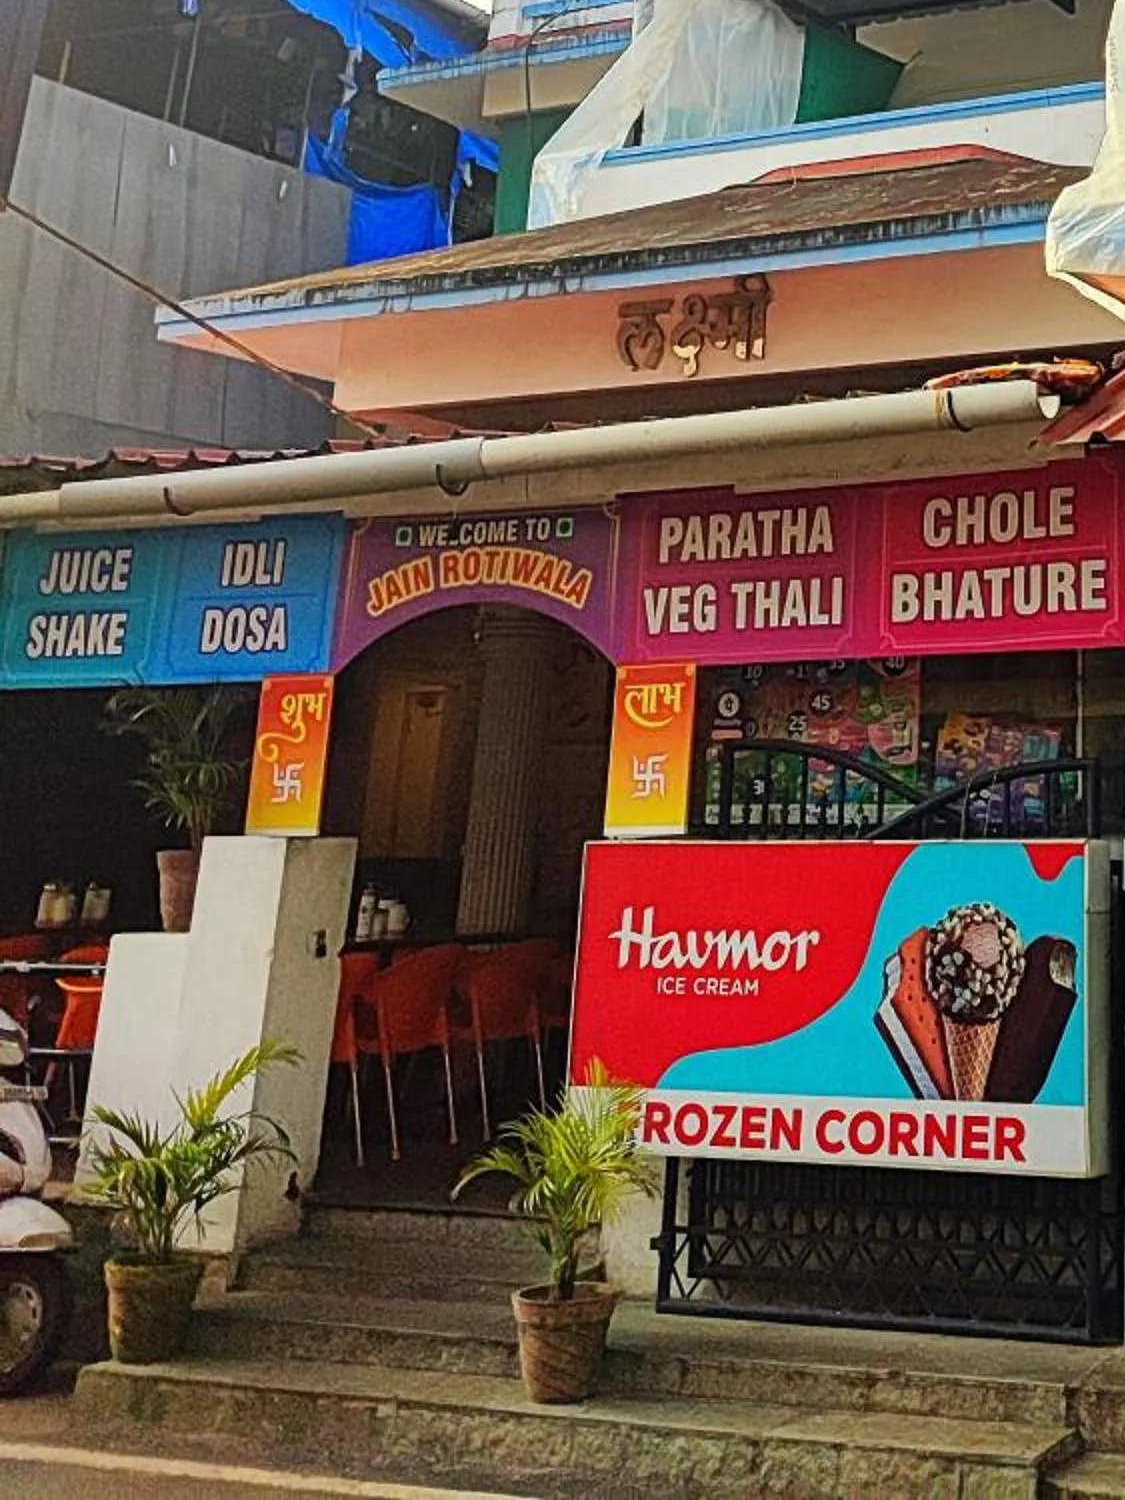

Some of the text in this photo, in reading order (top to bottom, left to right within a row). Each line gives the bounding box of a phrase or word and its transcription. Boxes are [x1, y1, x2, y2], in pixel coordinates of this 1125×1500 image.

[419, 518, 551, 546] WECOME TO
[658, 505, 834, 564] PARATHA
[923, 486, 1076, 548] CHOLE
[39, 548, 134, 595] JUICE
[221, 540, 286, 588] IDLI
[367, 547, 593, 617] JAIN ROTIWALA
[643, 576, 844, 635] VEG THALI
[891, 559, 1108, 624] BHATURE
[26, 612, 128, 659] SHAKE
[200, 607, 289, 654] DOSA
[624, 682, 686, 728] लाभ
[811, 694, 832, 711] 45
[607, 906, 820, 971] Havmor
[656, 977, 760, 997] ICE CREAM
[626, 1101, 1028, 1163] ROZEN CORNER
